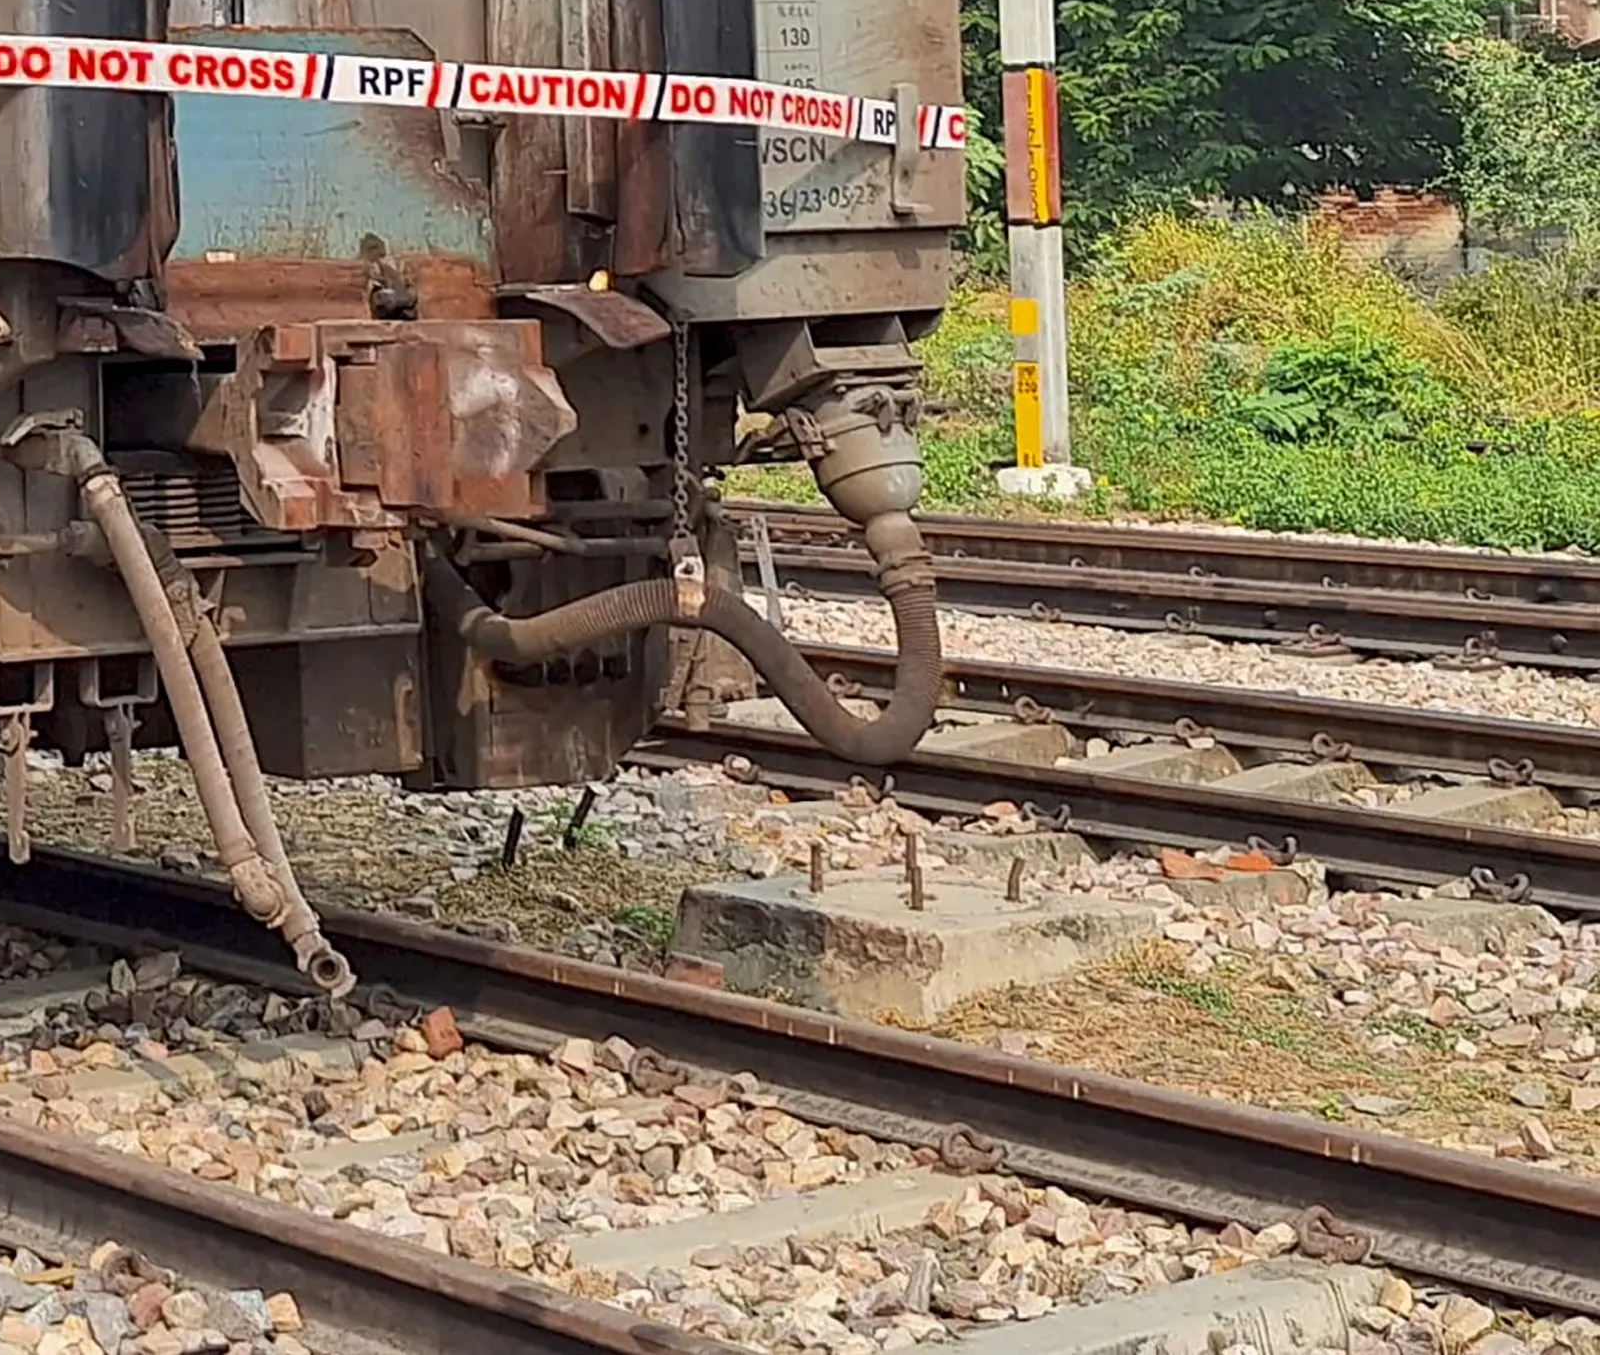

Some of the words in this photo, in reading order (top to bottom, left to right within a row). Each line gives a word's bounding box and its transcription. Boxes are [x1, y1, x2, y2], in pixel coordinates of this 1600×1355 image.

[780, 28, 810, 47] 130
[69, 48, 154, 84] NOT
[168, 53, 295, 91] CROSS
[359, 65, 426, 98] RPF
[469, 72, 627, 111] CAUTION
[671, 84, 716, 114] DO
[729, 86, 775, 121] NOT
[781, 93, 843, 130] CROSS
[873, 108, 897, 136] RP
